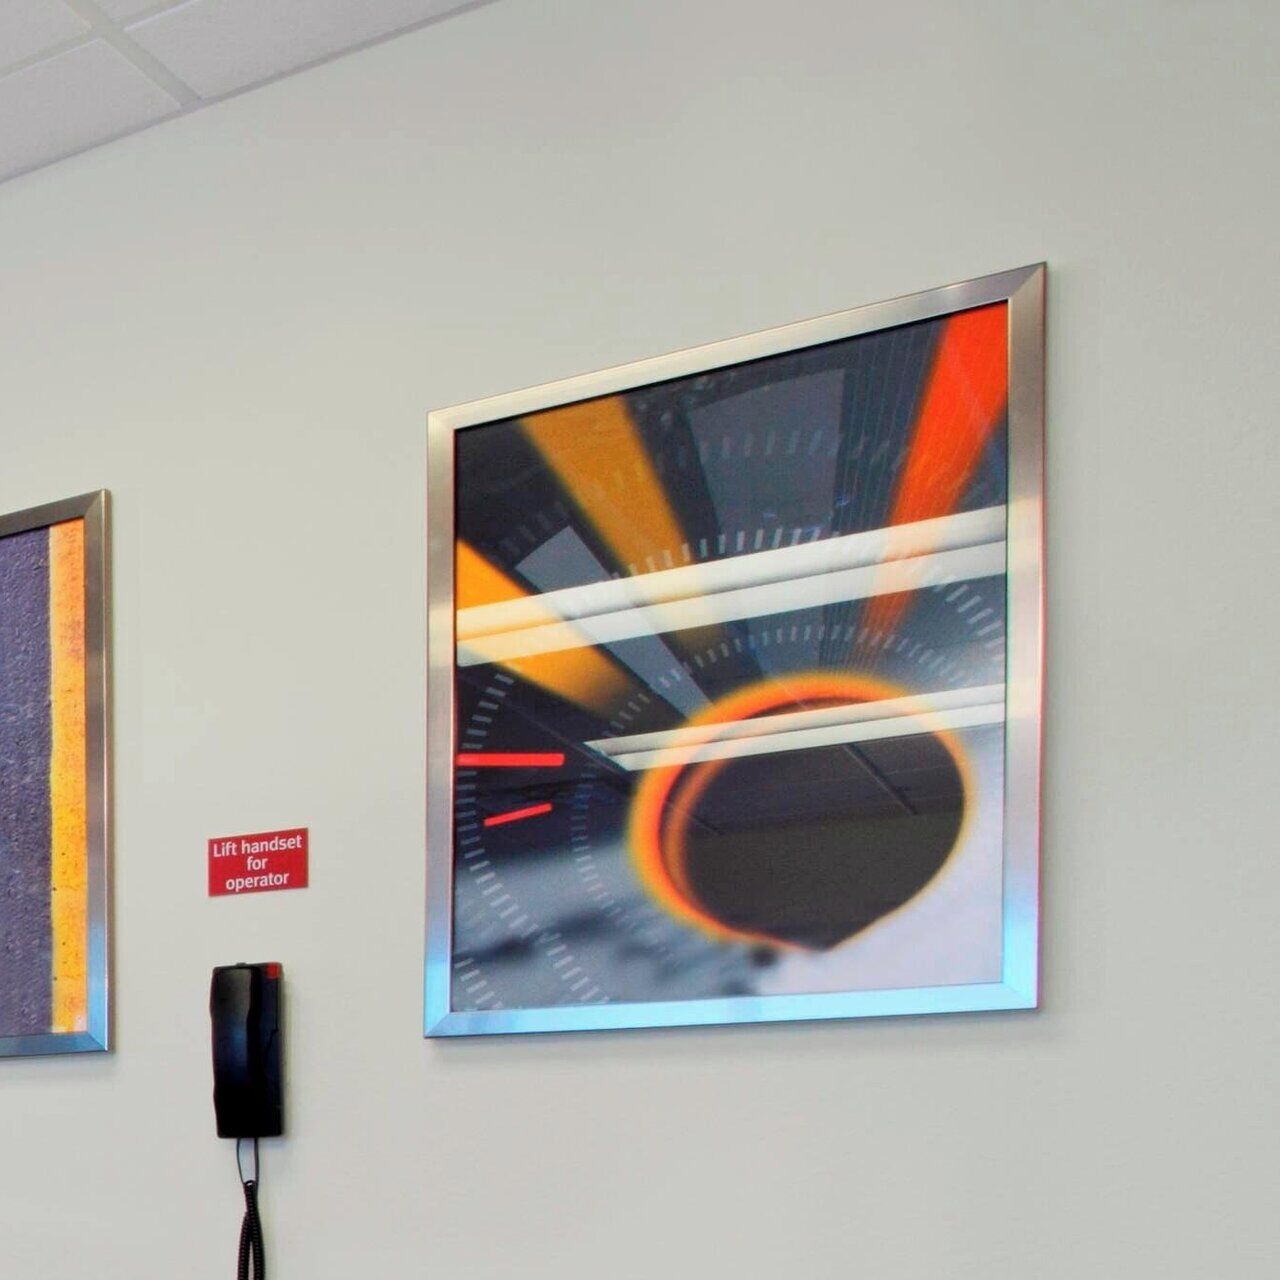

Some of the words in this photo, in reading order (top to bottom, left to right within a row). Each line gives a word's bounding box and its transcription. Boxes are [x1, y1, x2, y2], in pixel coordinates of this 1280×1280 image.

[213, 841, 237, 857] Lift
[241, 835, 302, 854] handset
[246, 856, 268, 871] for
[225, 873, 290, 892] operator
